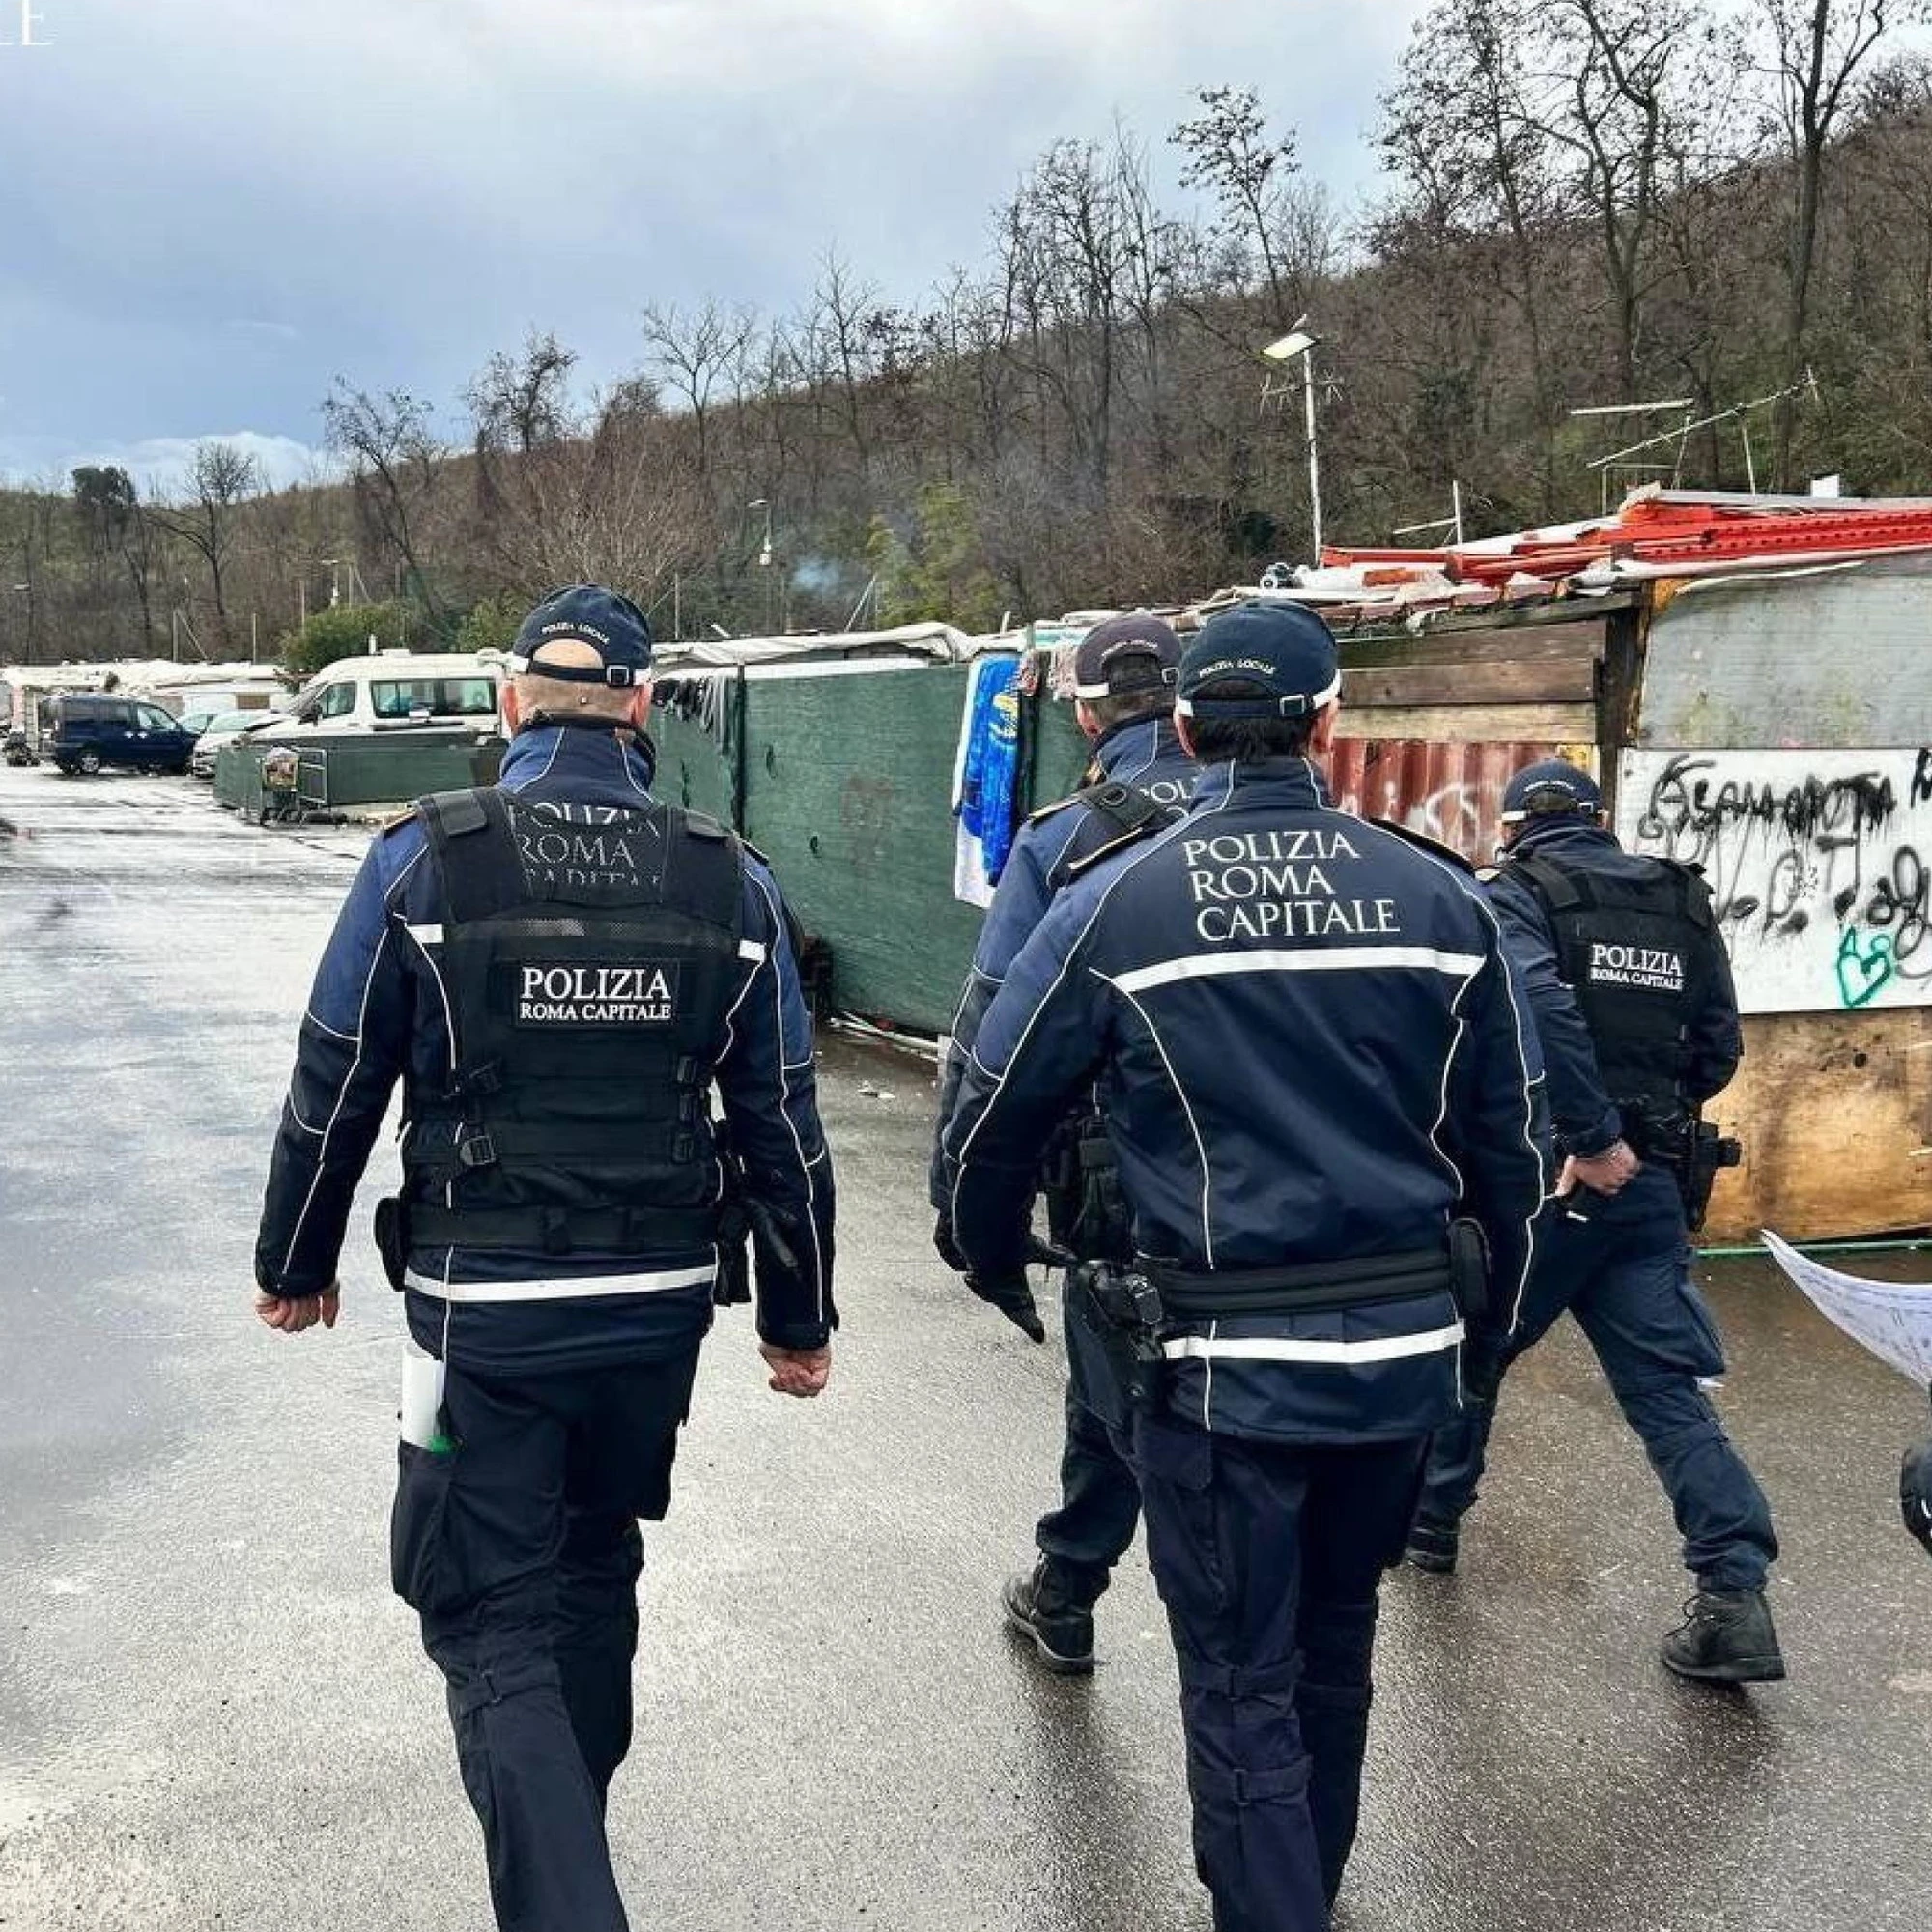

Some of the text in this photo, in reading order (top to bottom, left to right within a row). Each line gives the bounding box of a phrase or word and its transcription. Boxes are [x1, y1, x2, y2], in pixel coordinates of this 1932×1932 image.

[1182, 830, 1362, 867] POLIZIA
[1188, 864, 1338, 903] ROMA
[1195, 898, 1402, 943] CAPITALE
[1590, 943, 1684, 977] POLIZIA
[520, 966, 672, 1001] POLIZIA
[1589, 967, 1683, 991] ROMA CAPITALE
[519, 1002, 672, 1021] ROMA CAPITALE
